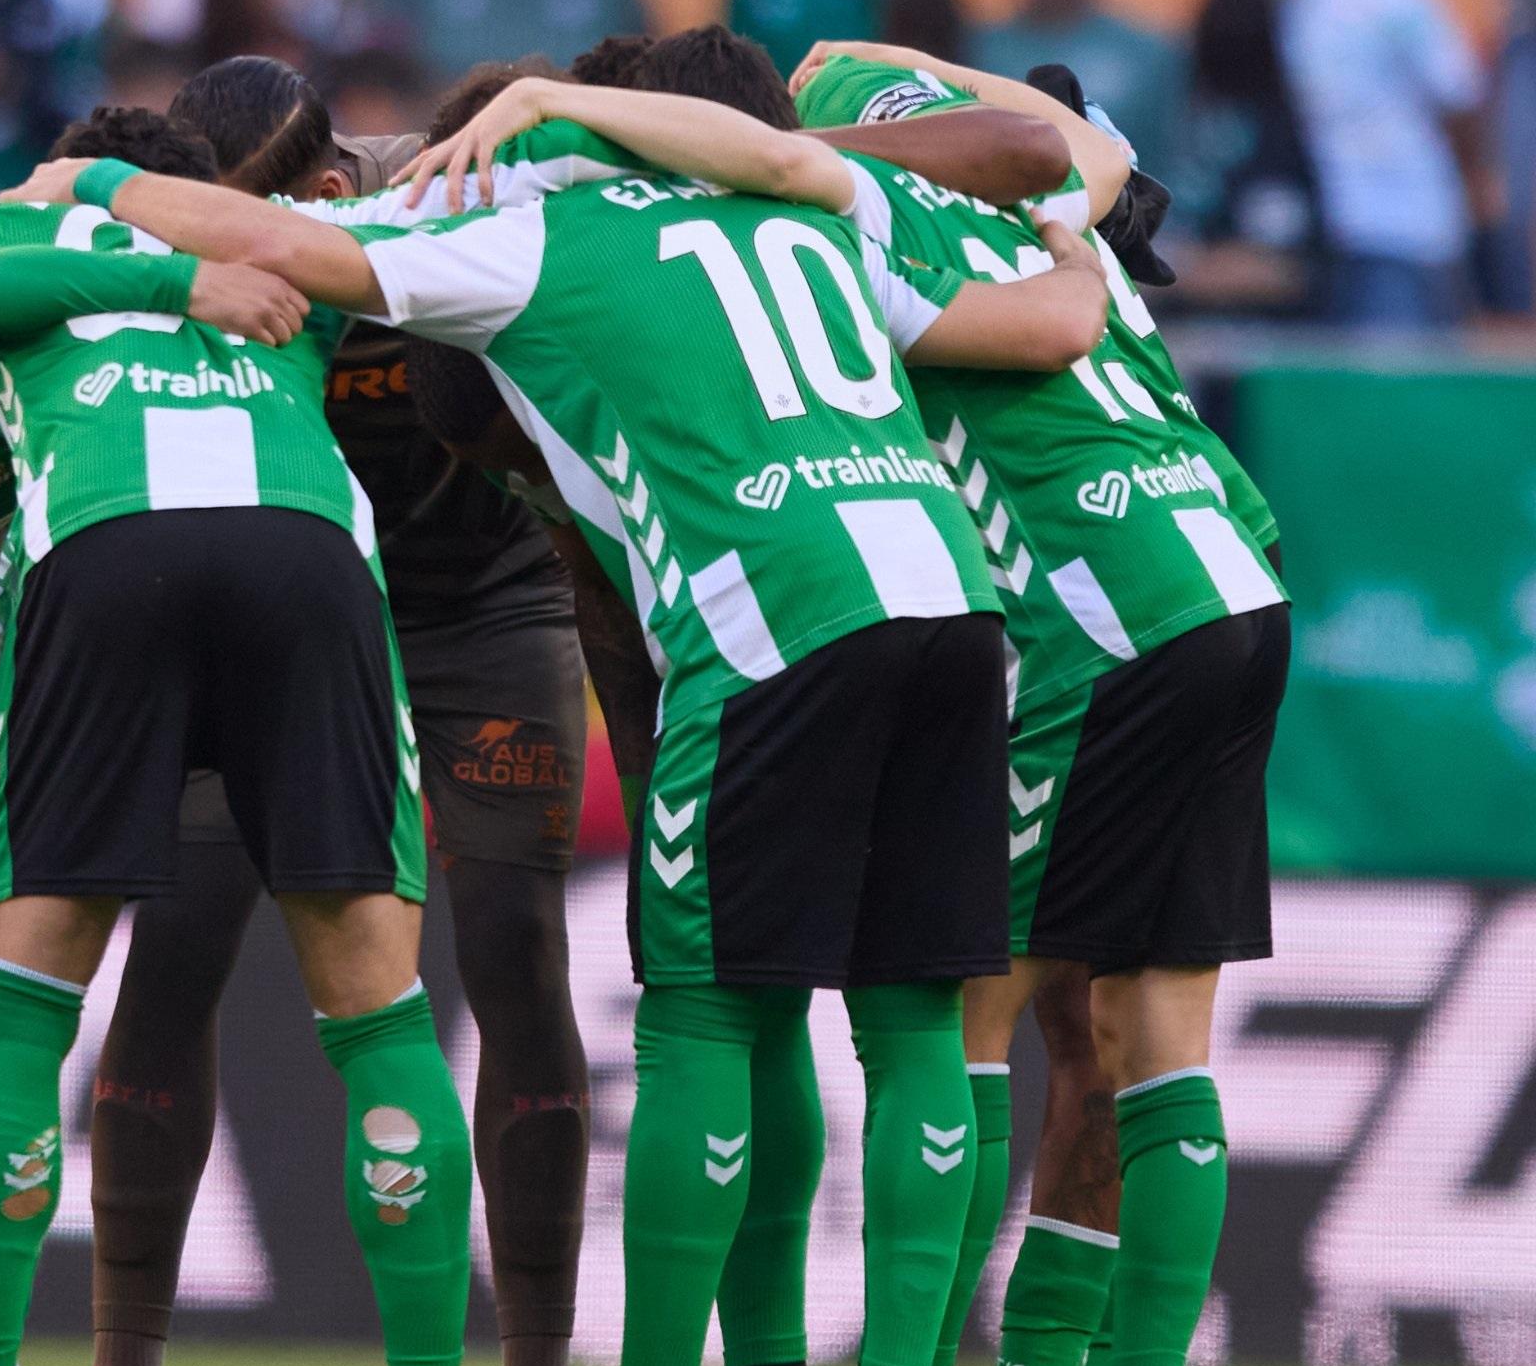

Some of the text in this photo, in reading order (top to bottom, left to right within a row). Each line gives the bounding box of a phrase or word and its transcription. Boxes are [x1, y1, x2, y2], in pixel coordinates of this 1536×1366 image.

[657, 217, 904, 422] 10
[492, 742, 556, 766] AUS
[452, 761, 569, 788] GLOBAL
